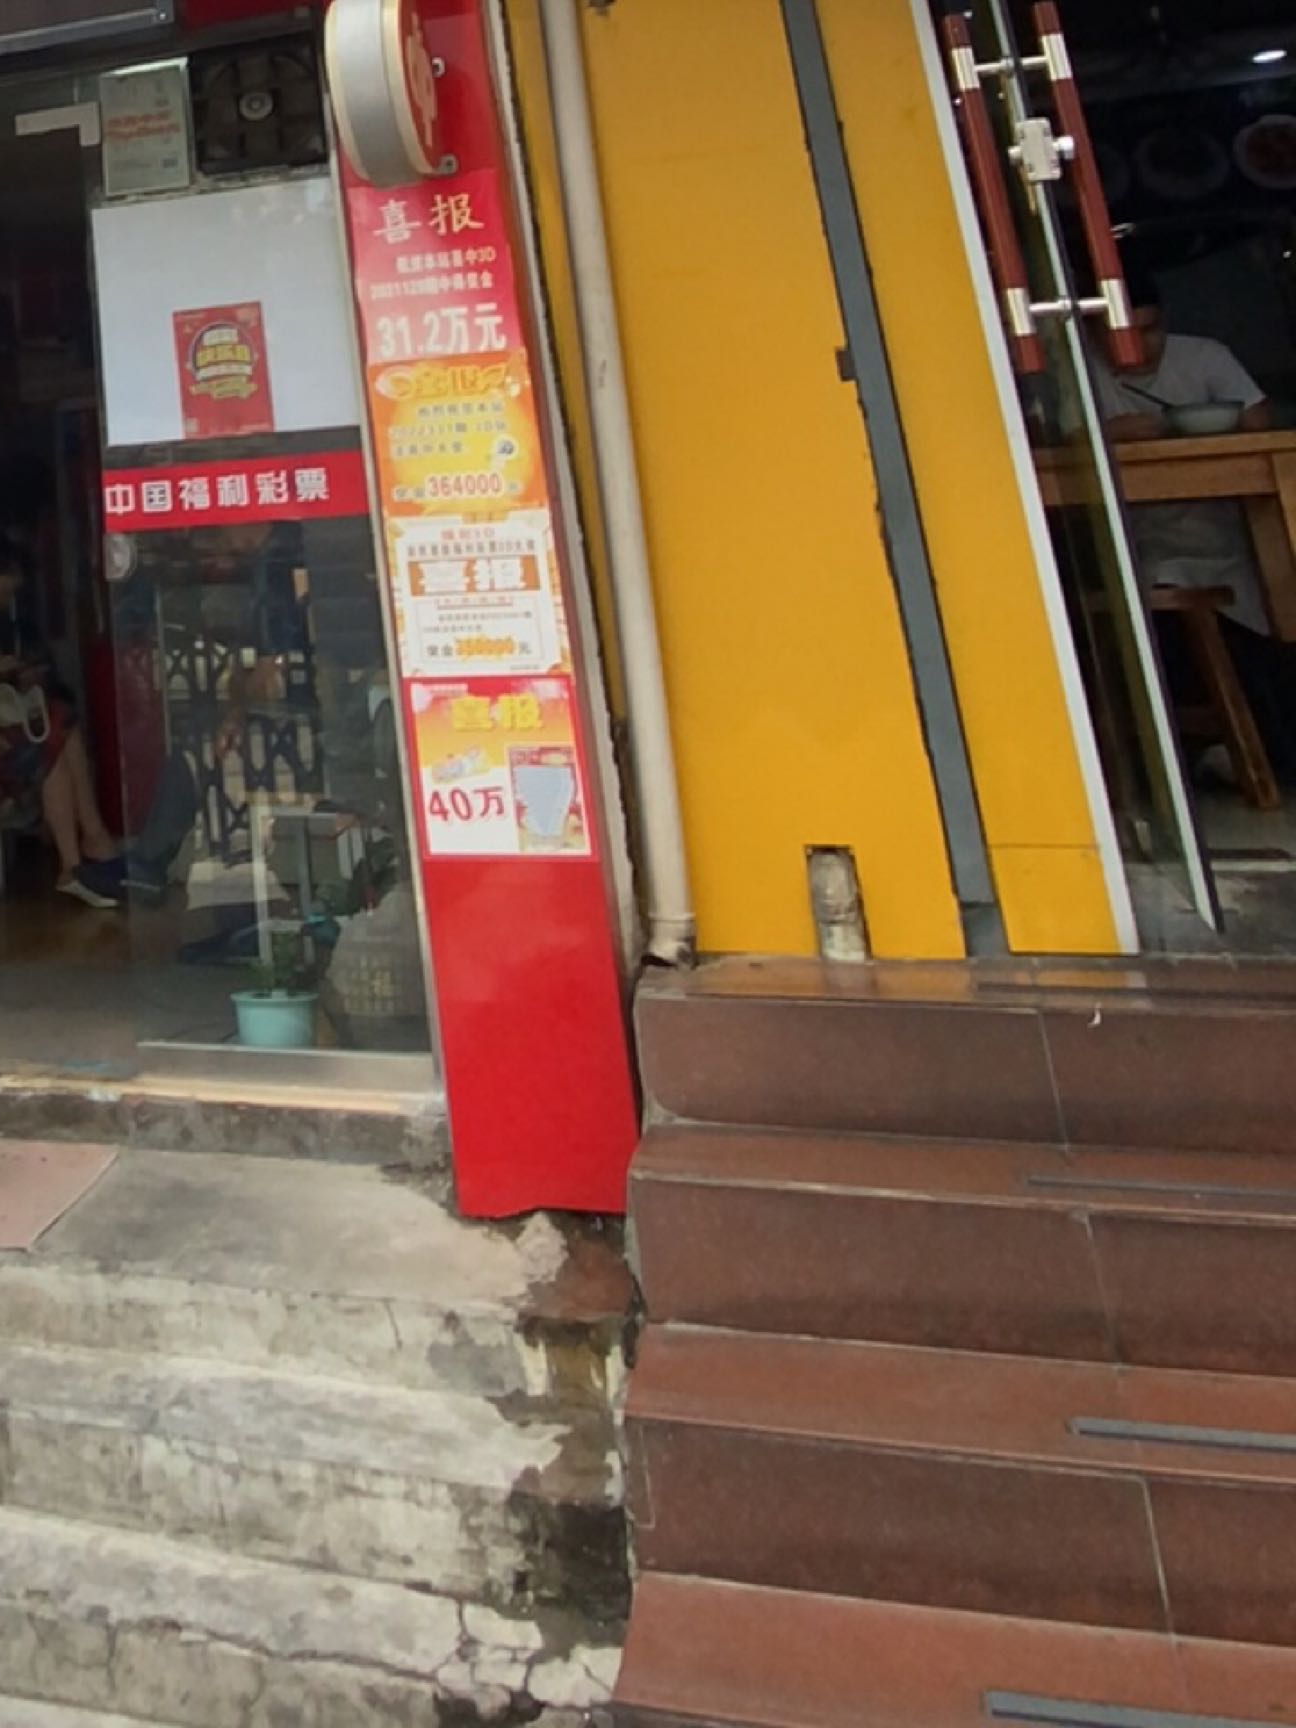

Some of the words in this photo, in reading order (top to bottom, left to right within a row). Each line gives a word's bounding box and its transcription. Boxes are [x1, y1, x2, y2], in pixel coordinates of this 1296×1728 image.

[373, 192, 485, 244] 喜报
[376, 302, 507, 359] 31.2万元
[104, 467, 331, 516] 中国福利彩票
[429, 786, 505, 822] 40万
